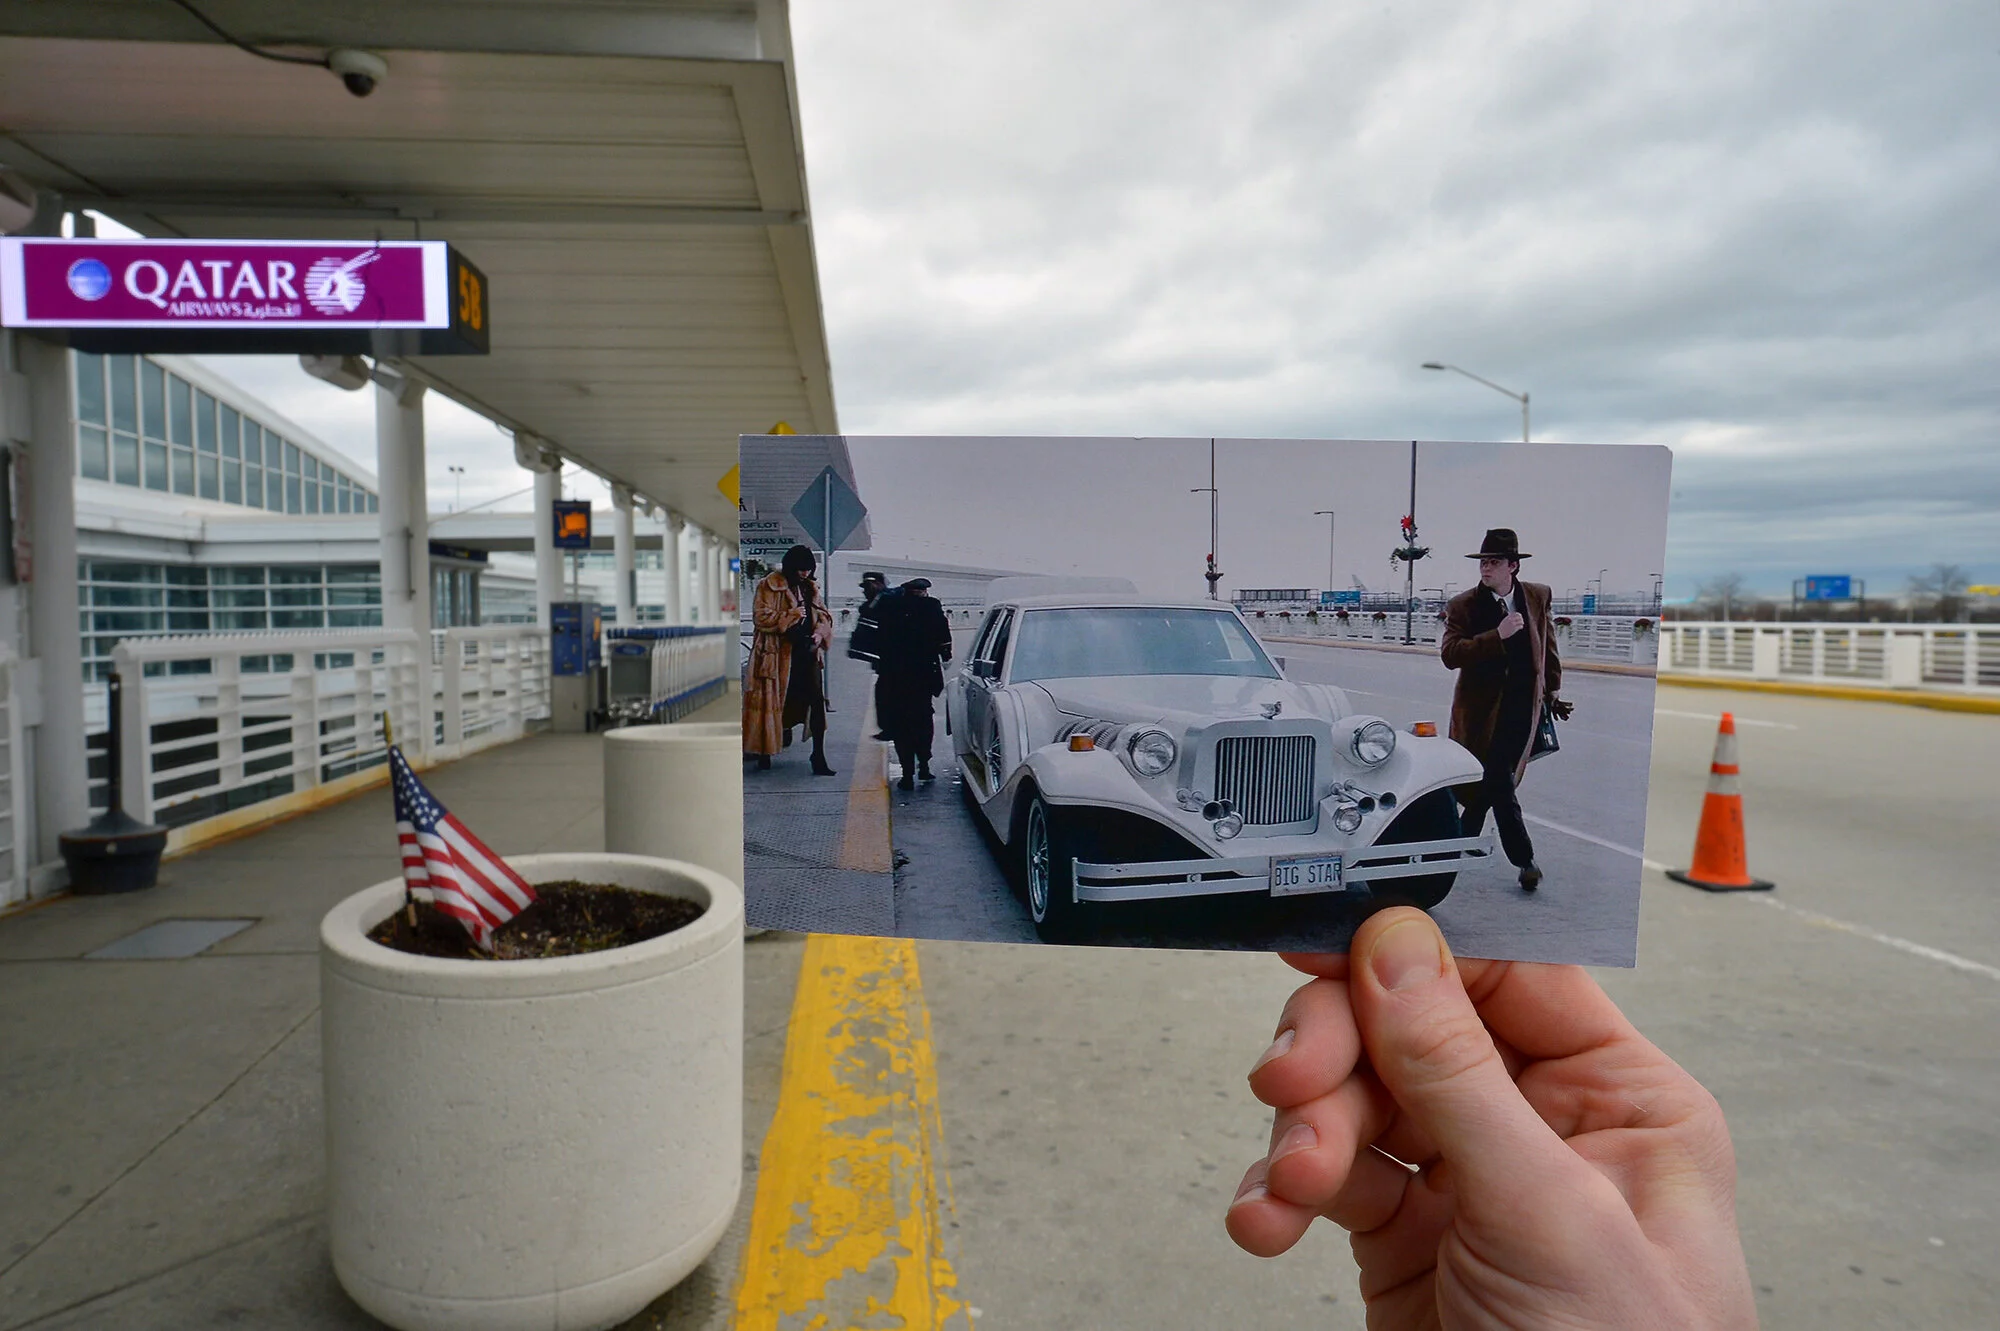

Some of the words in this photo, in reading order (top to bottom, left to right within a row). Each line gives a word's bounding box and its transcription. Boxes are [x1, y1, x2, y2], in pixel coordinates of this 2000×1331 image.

[124, 259, 300, 307] QATAR
[459, 265, 482, 331] 5B
[167, 301, 240, 317] AIRWAYS
[1275, 866, 1299, 886] BIG
[1308, 863, 1341, 883] STAR
